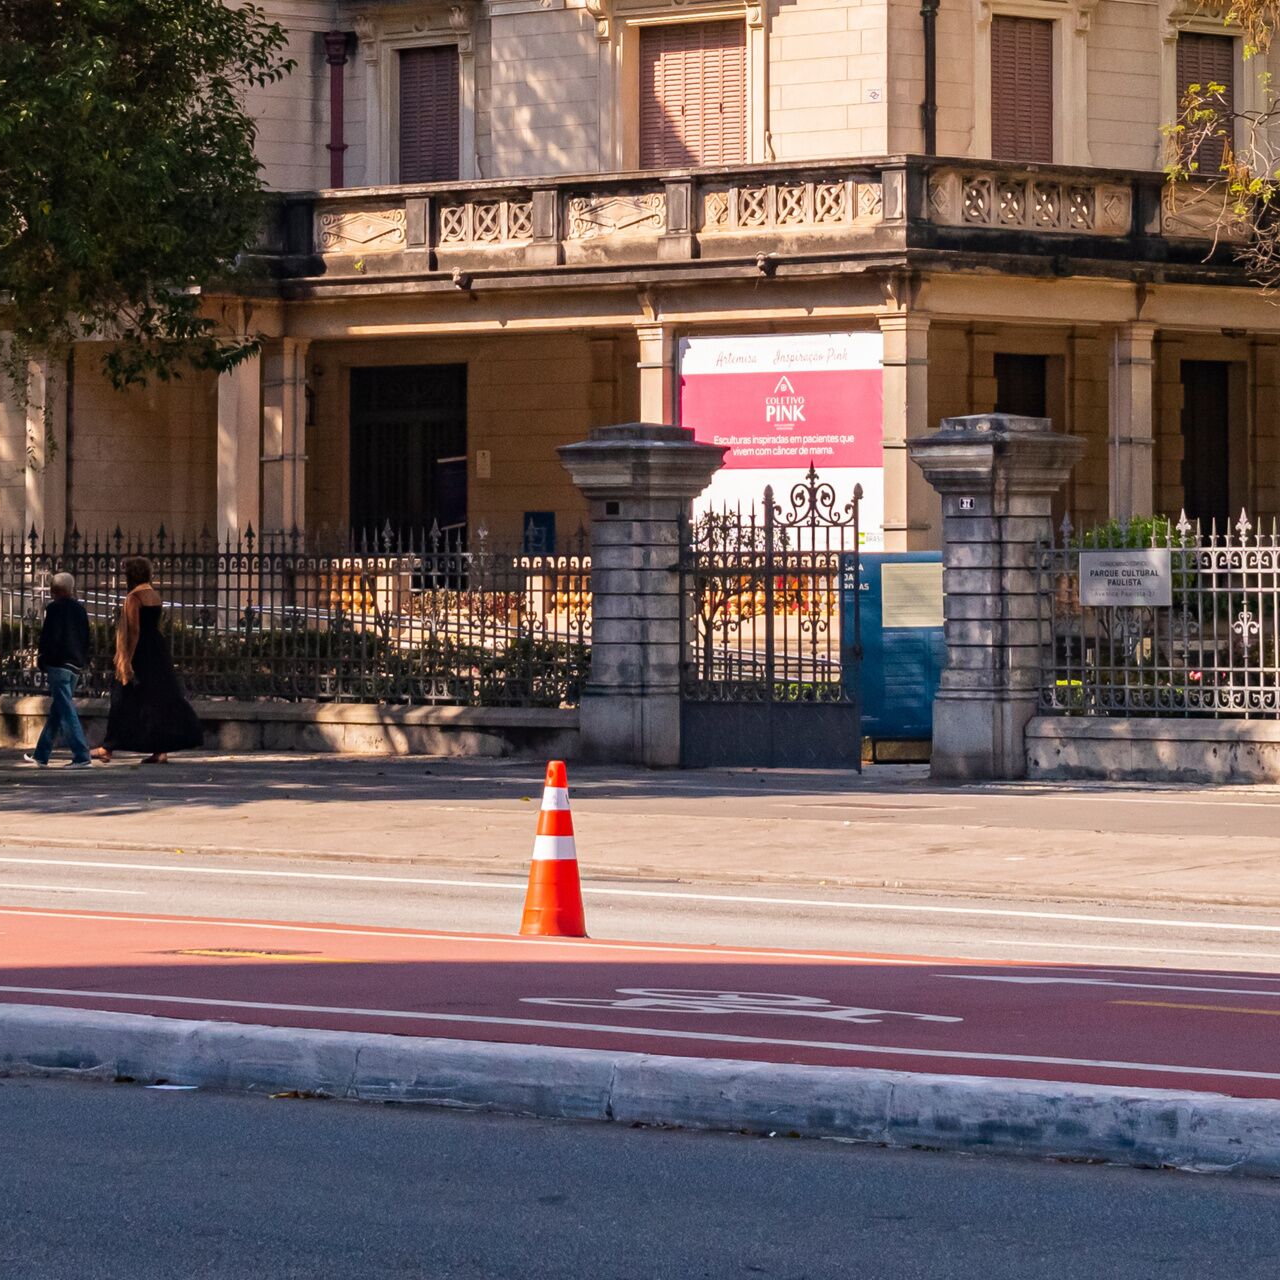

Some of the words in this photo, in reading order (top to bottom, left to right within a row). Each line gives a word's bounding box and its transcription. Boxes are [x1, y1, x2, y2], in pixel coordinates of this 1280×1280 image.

[765, 396, 805, 405] COLETIVO
[766, 405, 806, 422] PINK
[713, 435, 752, 445] Esculturas
[752, 434, 789, 447] inspiradas
[789, 437, 803, 445] em
[803, 434, 838, 446] pacientes
[839, 435, 854, 446] que
[733, 446, 756, 456] vivem
[756, 448, 772, 456] com
[798, 445, 809, 456] de
[1089, 569, 1119, 577] PARQUE
[1121, 569, 1160, 577] CULTURAL
[1107, 578, 1142, 586] PAULISTA
